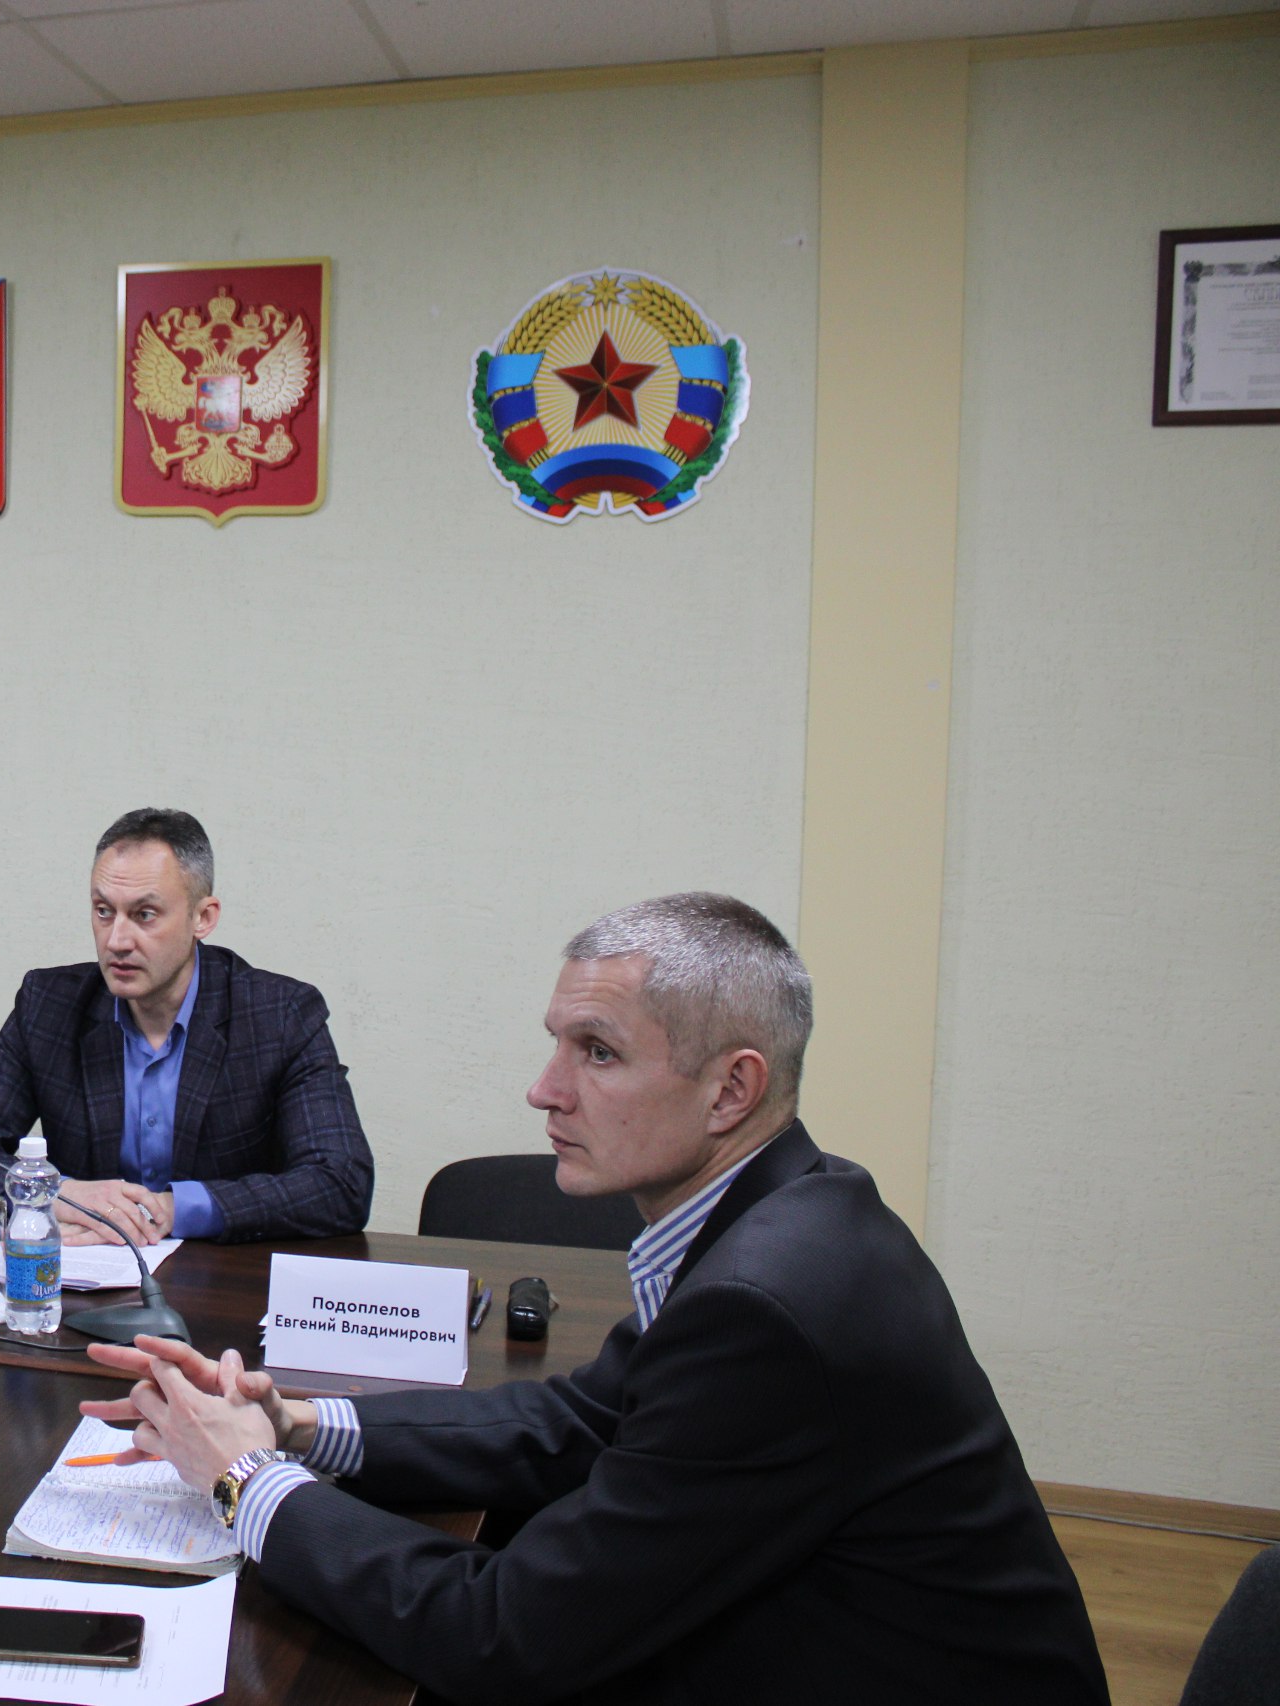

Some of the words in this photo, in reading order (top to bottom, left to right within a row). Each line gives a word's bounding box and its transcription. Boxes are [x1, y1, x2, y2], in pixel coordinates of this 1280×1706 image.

[312, 1296, 421, 1319] Подоплелов
[274, 1314, 337, 1333] Евгений
[341, 1320, 456, 1344] Владимирович
